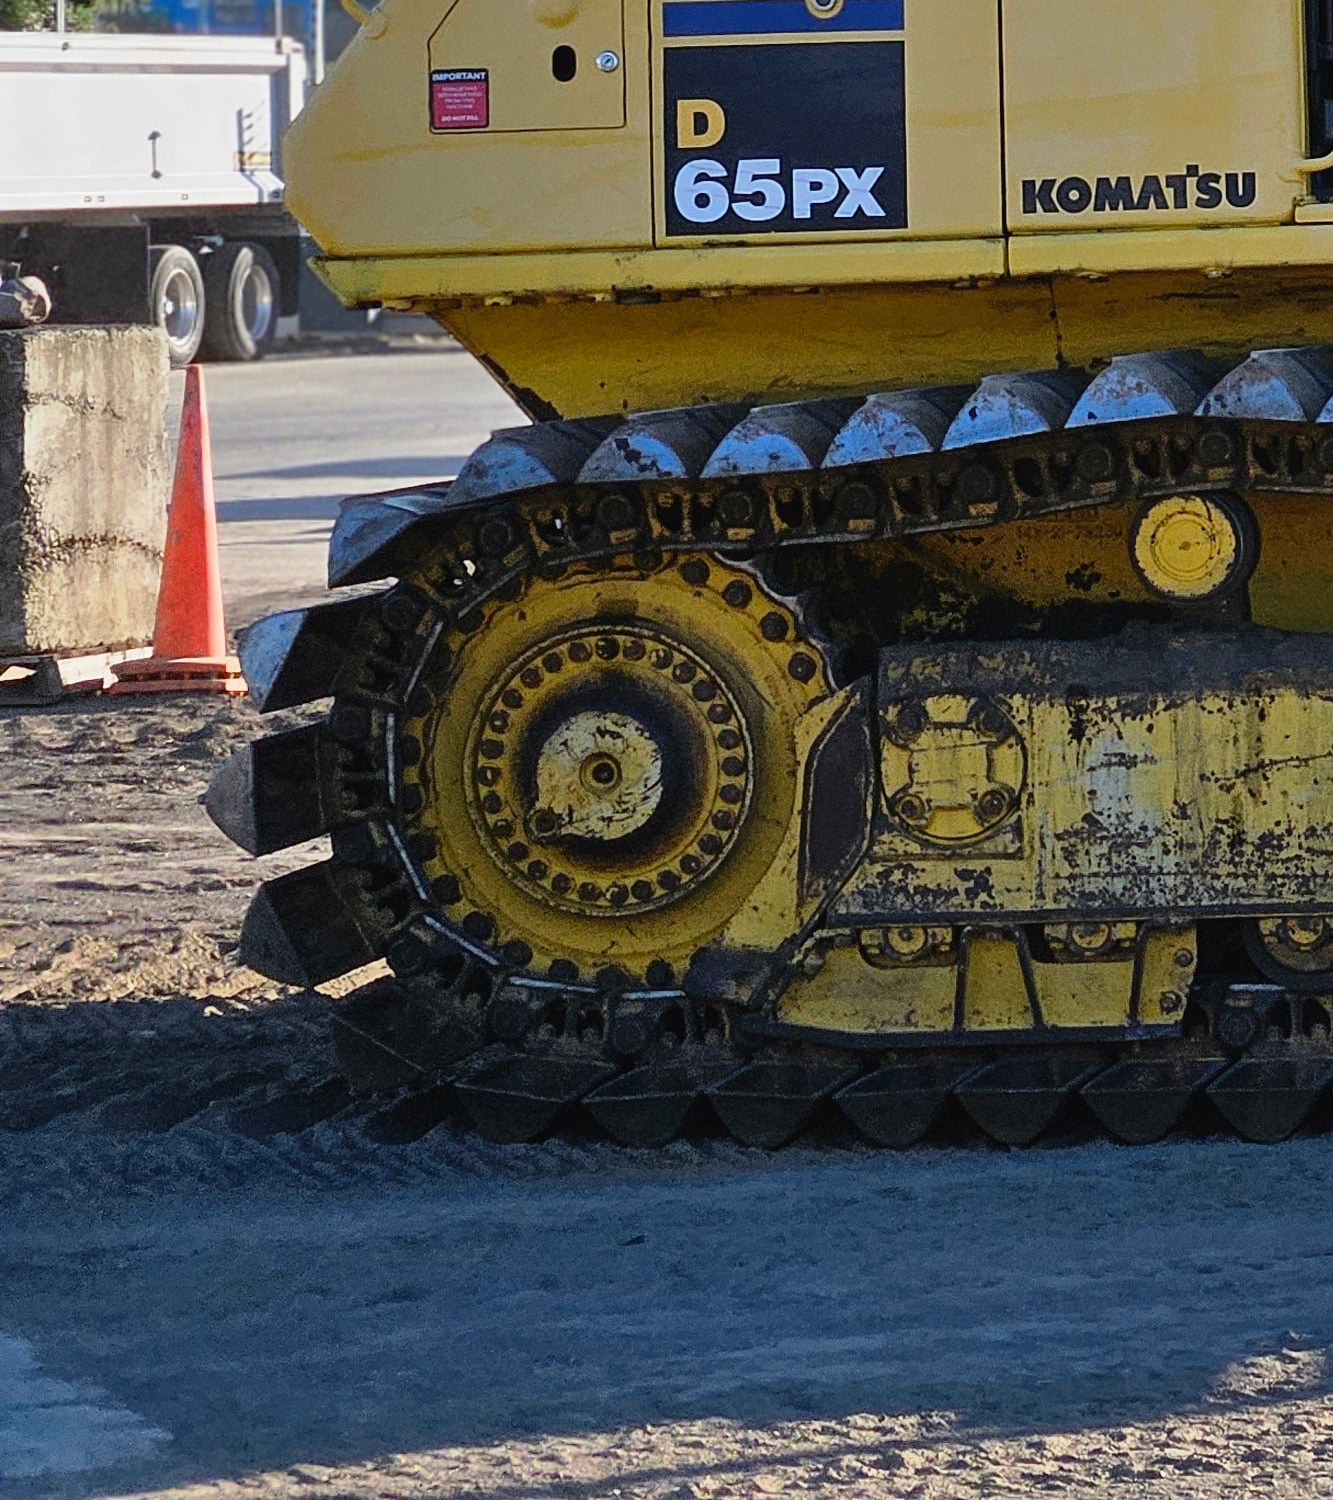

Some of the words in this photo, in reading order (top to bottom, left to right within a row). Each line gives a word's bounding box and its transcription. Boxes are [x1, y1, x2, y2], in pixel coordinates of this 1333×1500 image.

[432, 71, 487, 81] IMPORTANT
[676, 98, 726, 149] D
[674, 158, 887, 223] 65PX
[1021, 164, 1257, 214] KOMATSU
